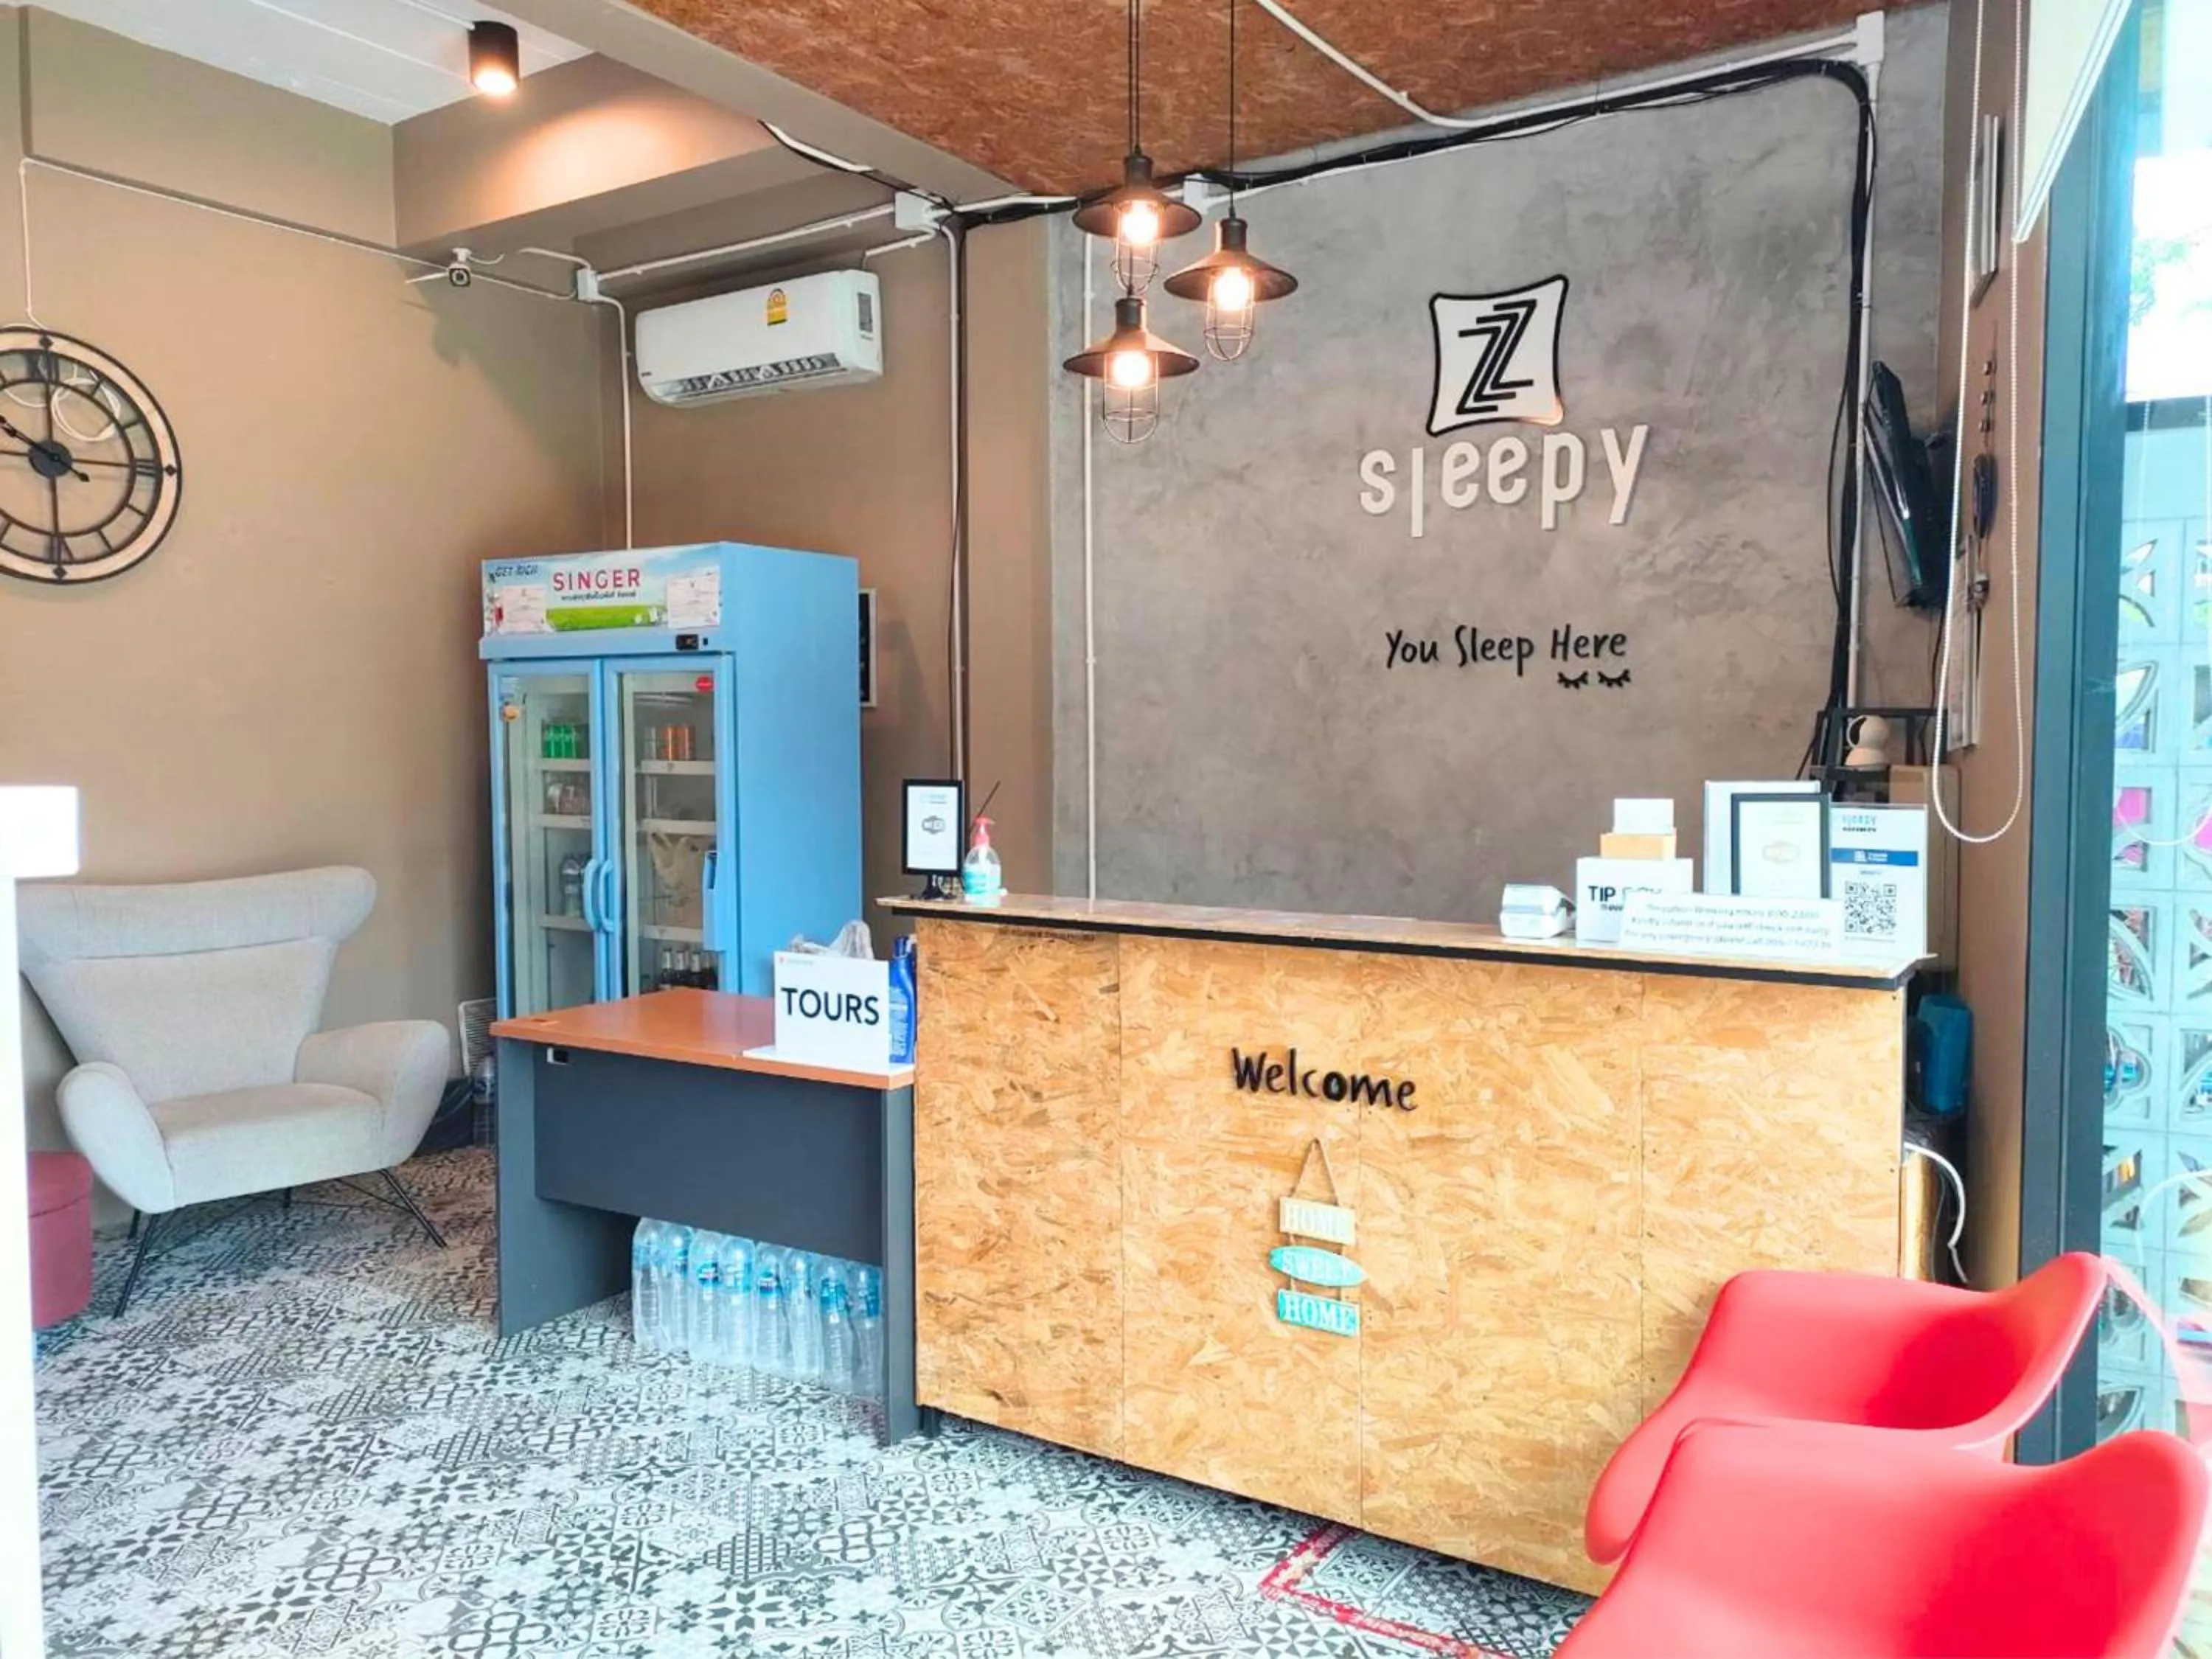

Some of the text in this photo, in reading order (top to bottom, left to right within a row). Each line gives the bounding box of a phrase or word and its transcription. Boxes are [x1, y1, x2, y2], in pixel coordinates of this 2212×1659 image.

[553, 568, 641, 591] SINGER
[1385, 625, 1627, 677] You Sleep Here
[1587, 886, 1616, 902] TIP
[781, 987, 880, 1025] TOURS
[1231, 1048, 1418, 1111] Welcome
[1285, 1293, 1357, 1334] HOME
